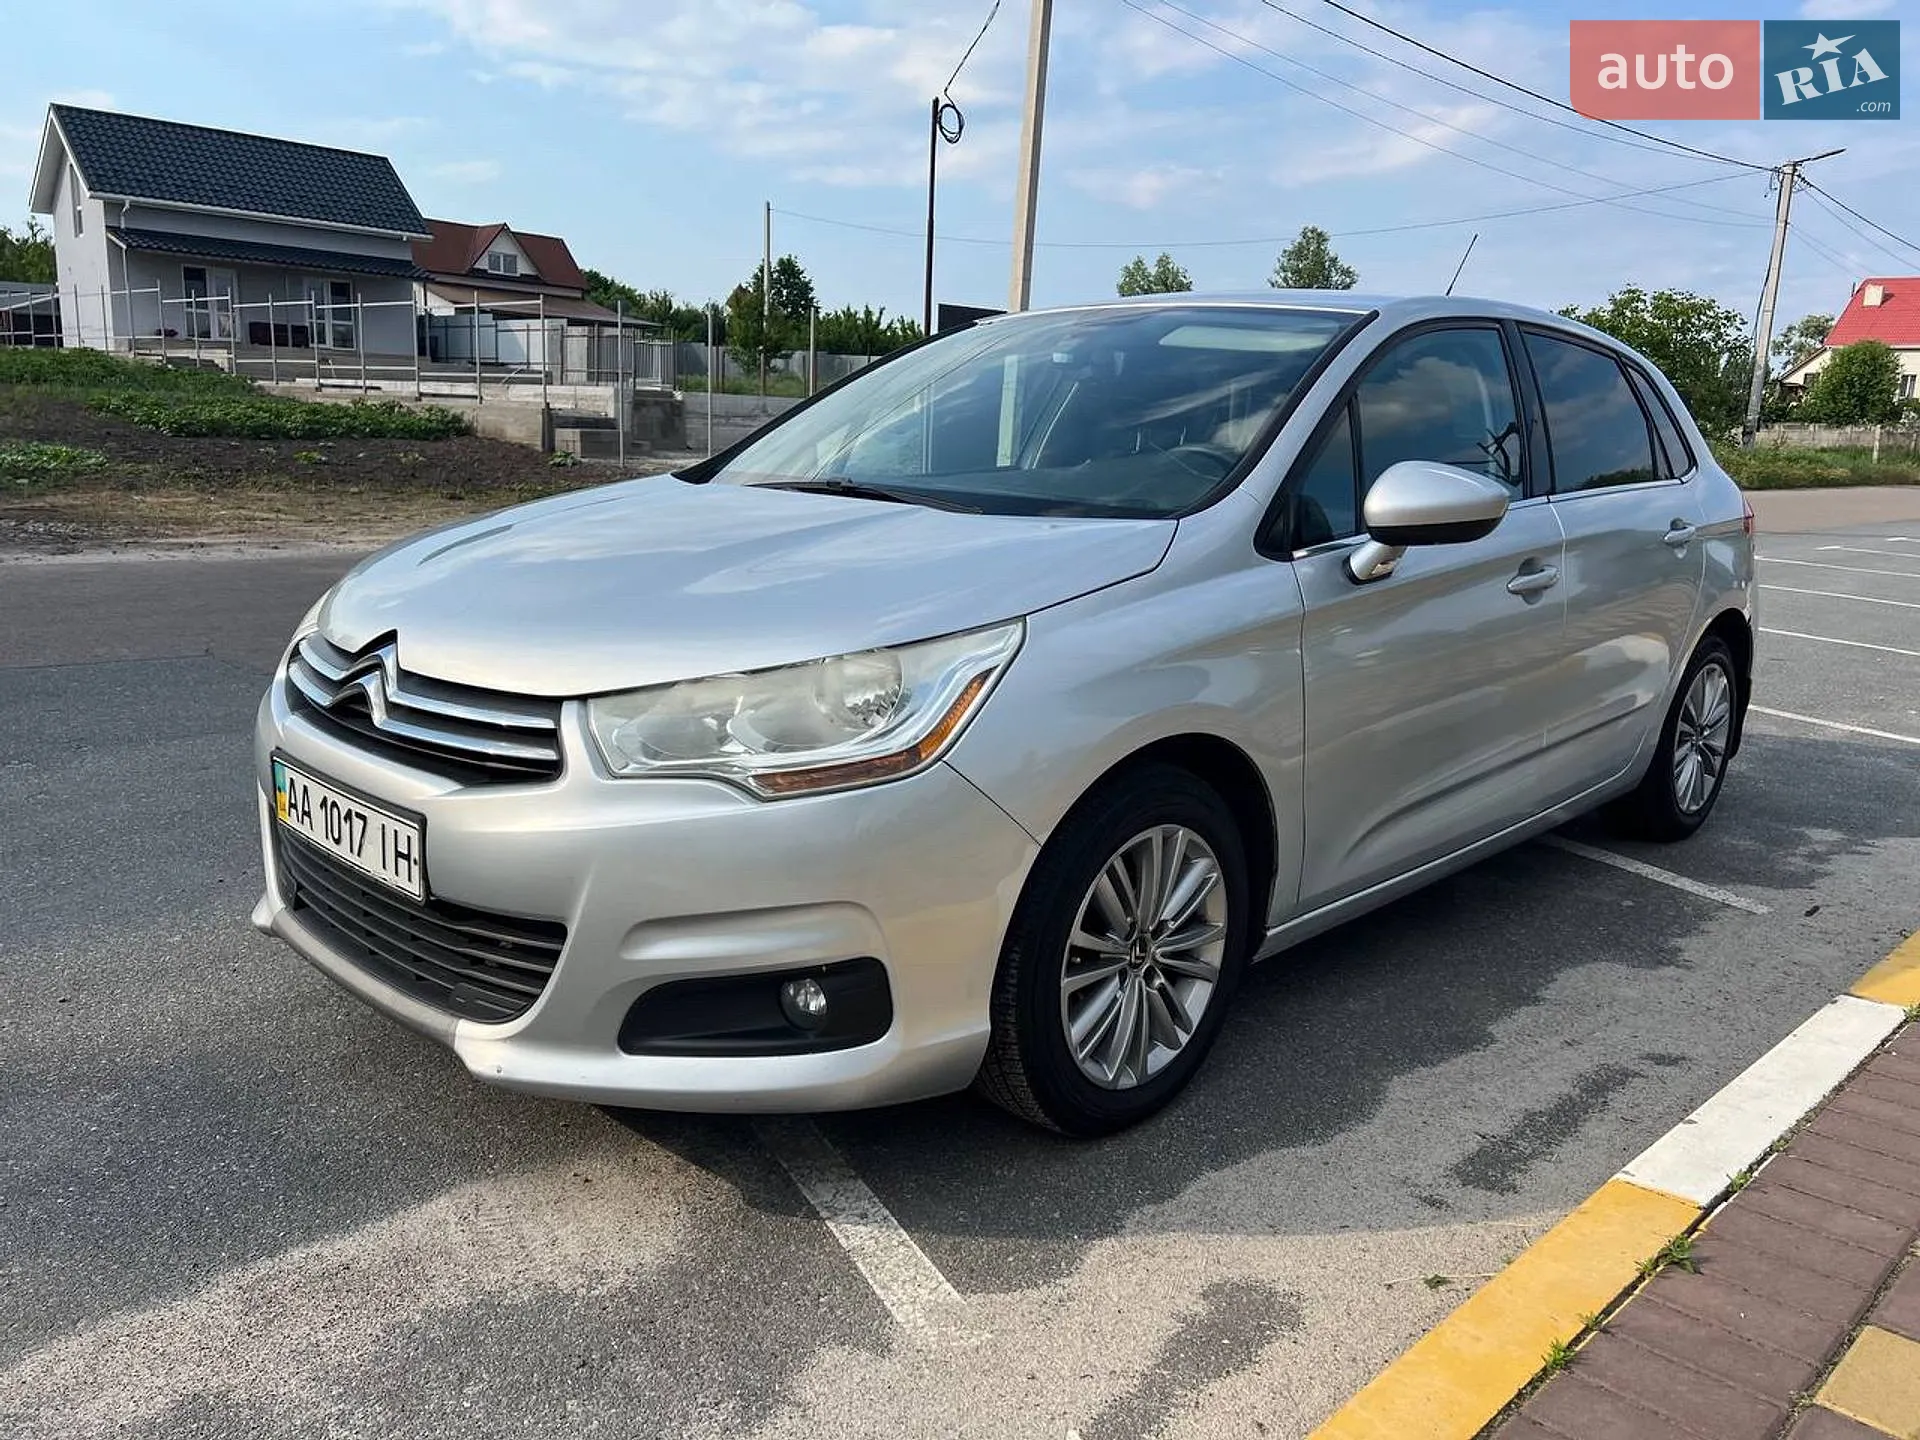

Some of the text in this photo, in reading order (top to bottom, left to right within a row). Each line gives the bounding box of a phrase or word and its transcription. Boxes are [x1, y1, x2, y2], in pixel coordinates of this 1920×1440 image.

[288, 777, 412, 883] AA 1017 IH
